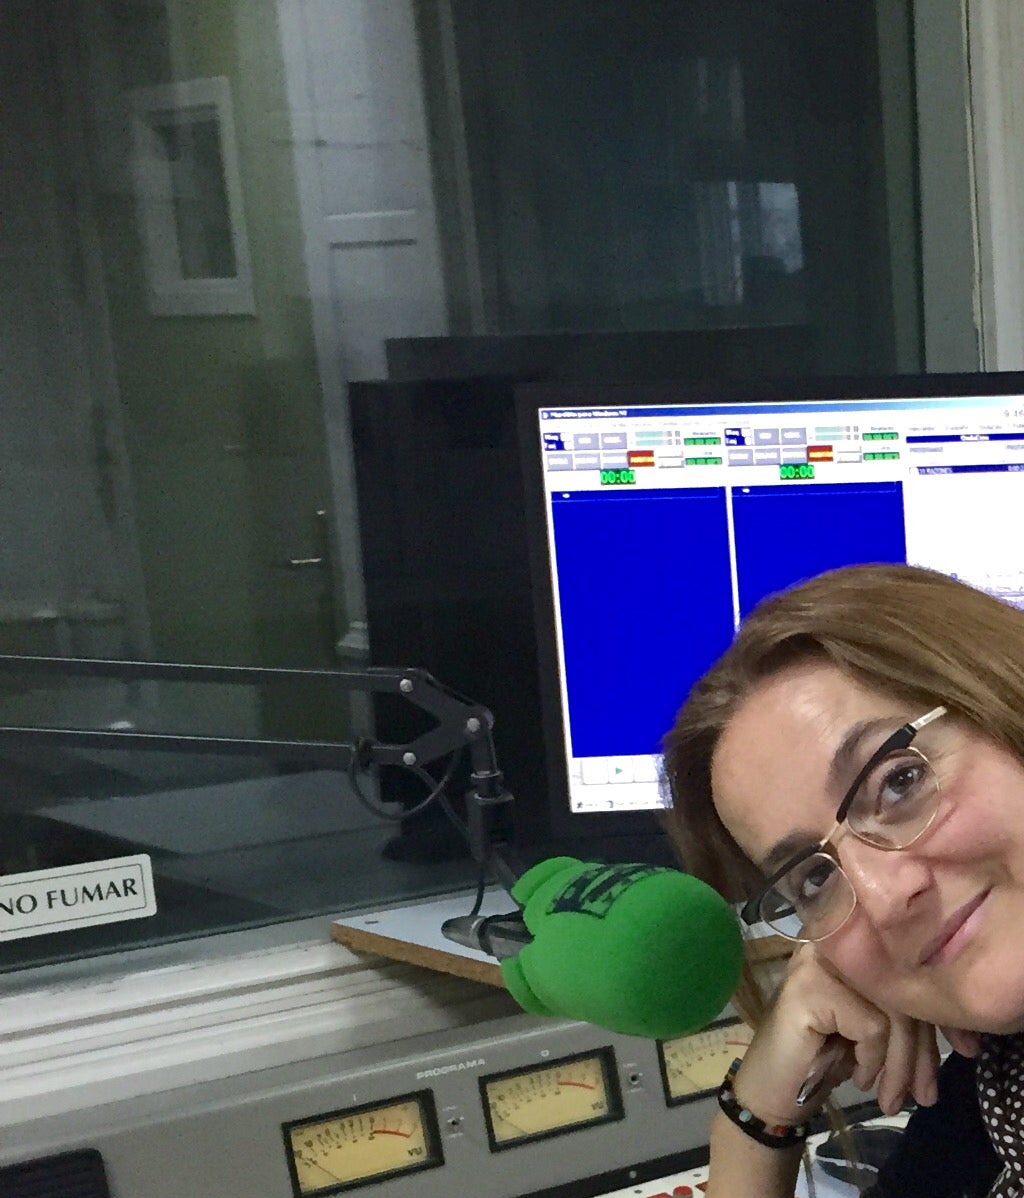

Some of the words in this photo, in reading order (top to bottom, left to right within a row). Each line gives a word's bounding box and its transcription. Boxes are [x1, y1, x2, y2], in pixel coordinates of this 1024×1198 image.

[600, 470, 636, 484] 00:00
[779, 465, 815, 480] 00:00
[0, 894, 38, 916] NO
[46, 877, 138, 909] FUMAR
[416, 1058, 486, 1079] PROGRAMA
